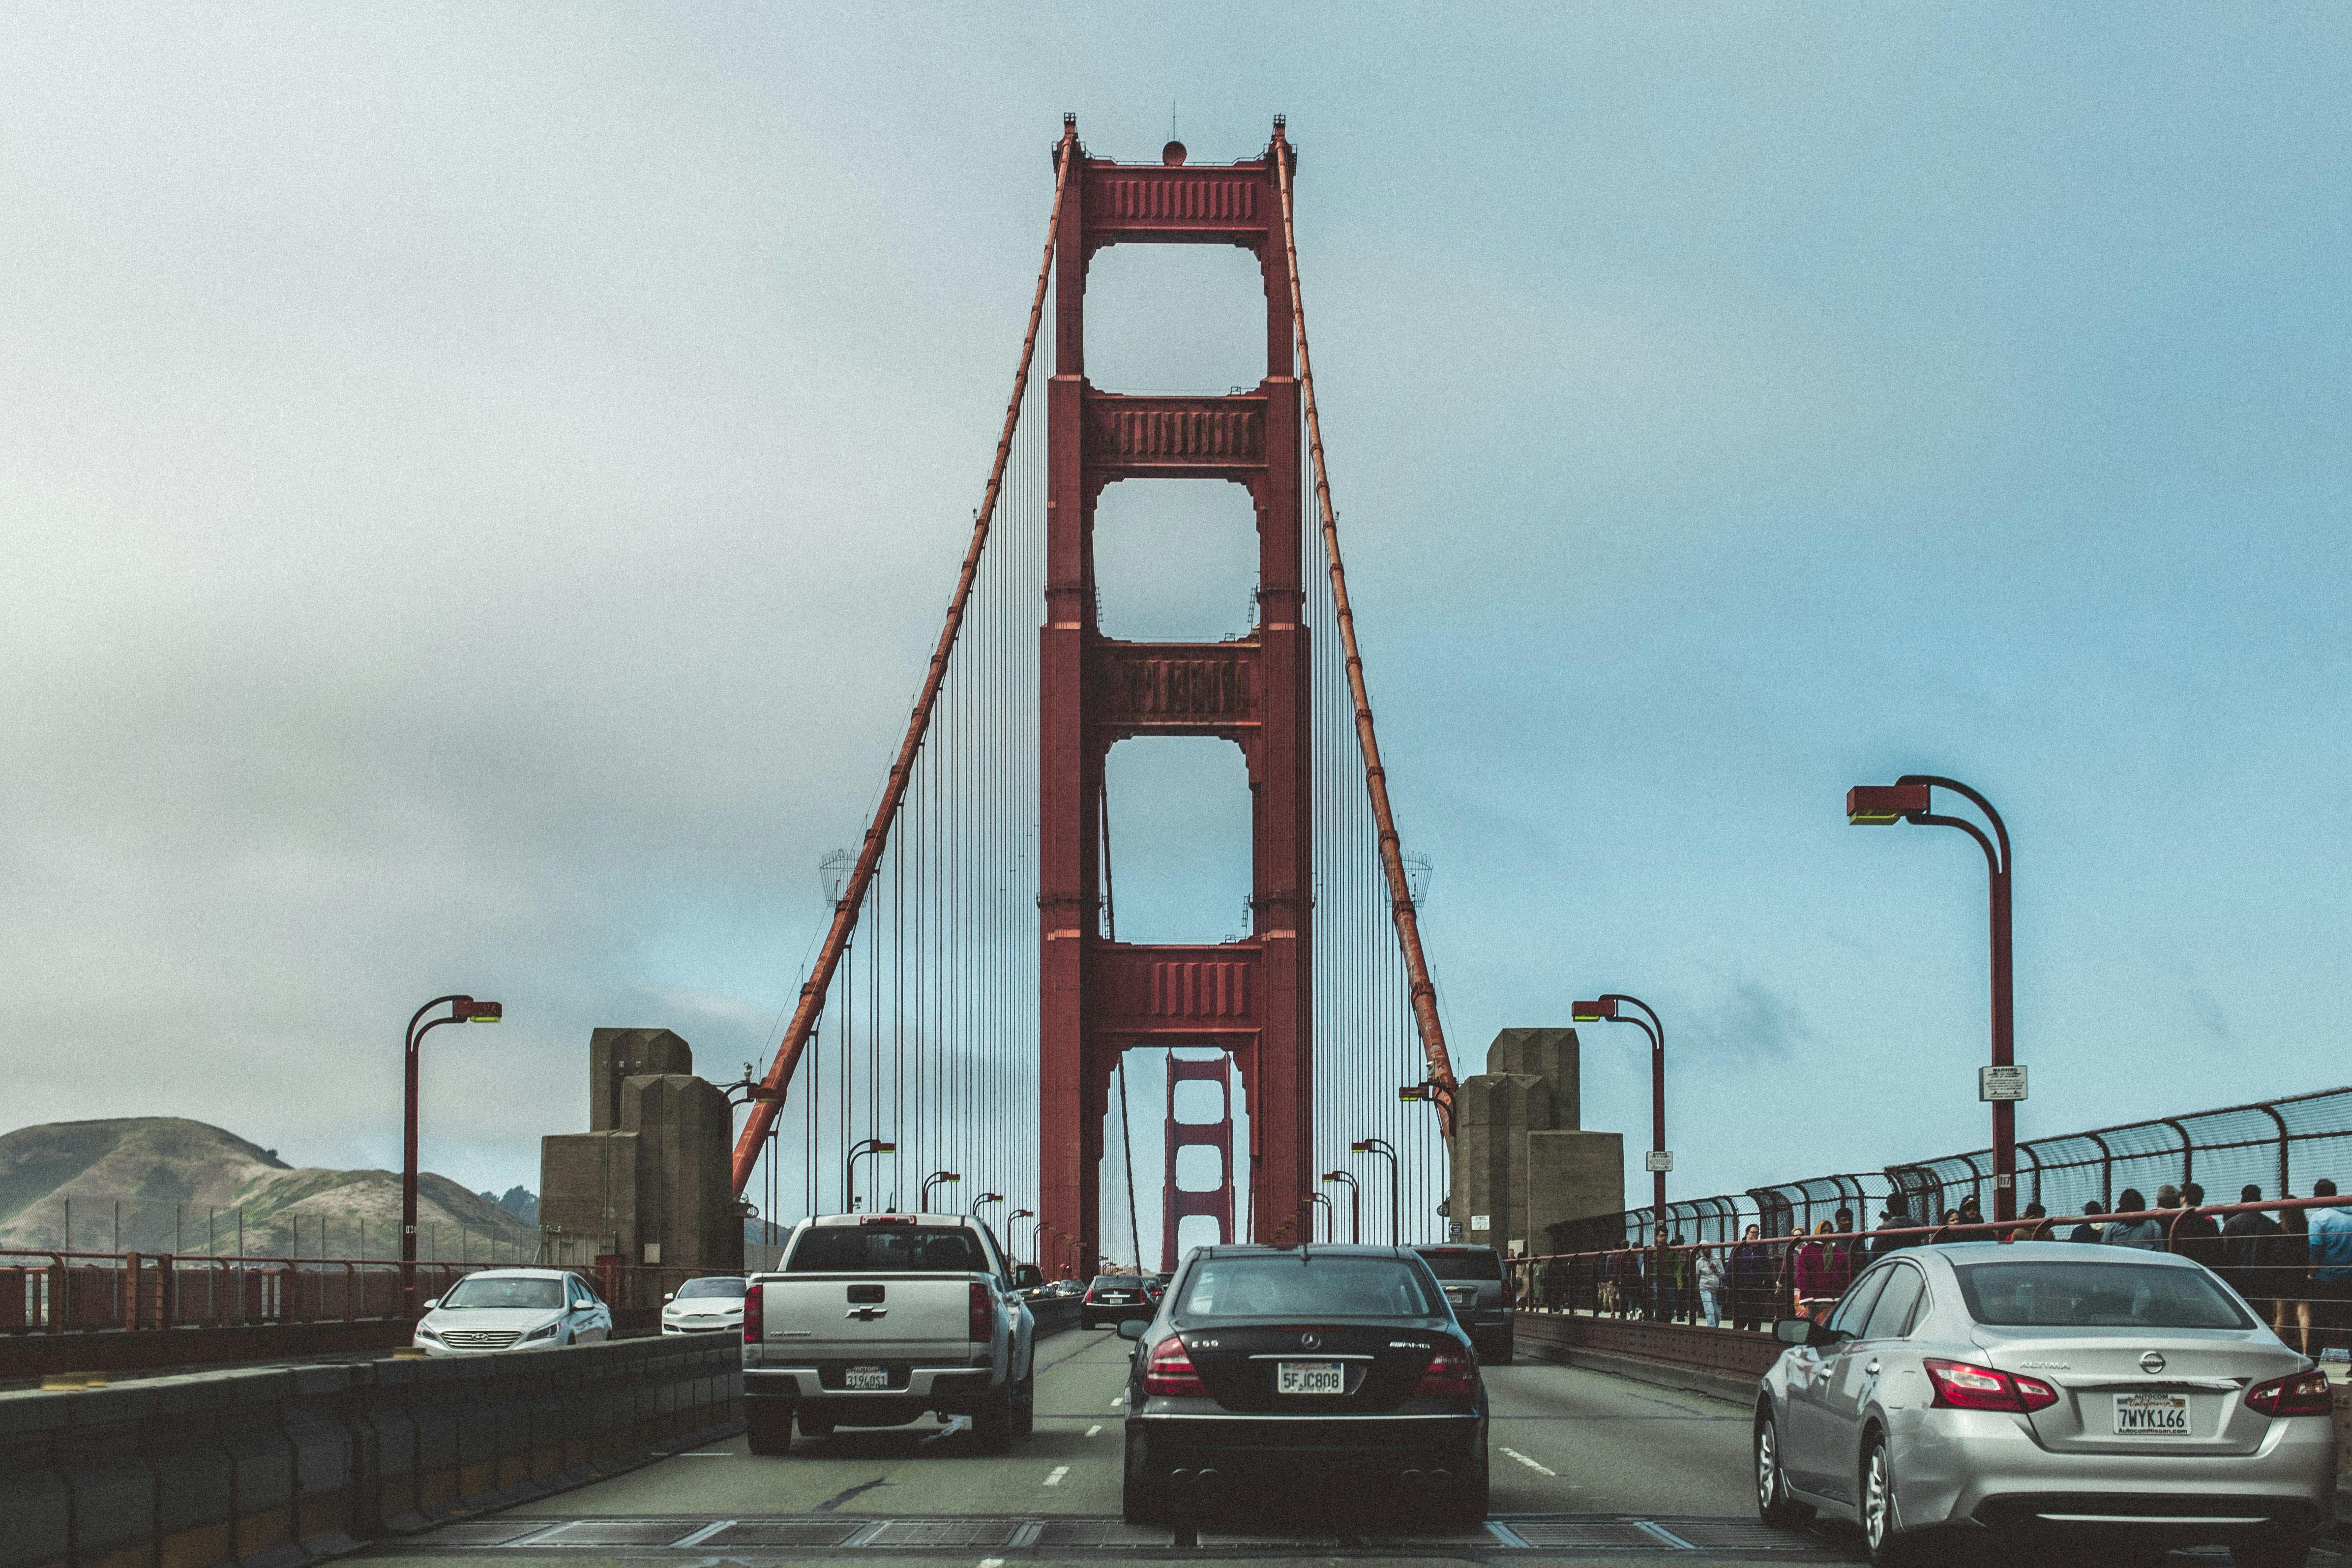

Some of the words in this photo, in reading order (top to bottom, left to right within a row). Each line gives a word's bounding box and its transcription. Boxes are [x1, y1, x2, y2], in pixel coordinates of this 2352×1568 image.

[2020, 1361, 2071, 1370] ALTIMA
[1283, 1372, 1339, 1389] 5FJC808
[2129, 1399, 2170, 1409] California
[2118, 1409, 2185, 1428] 7WYK166
